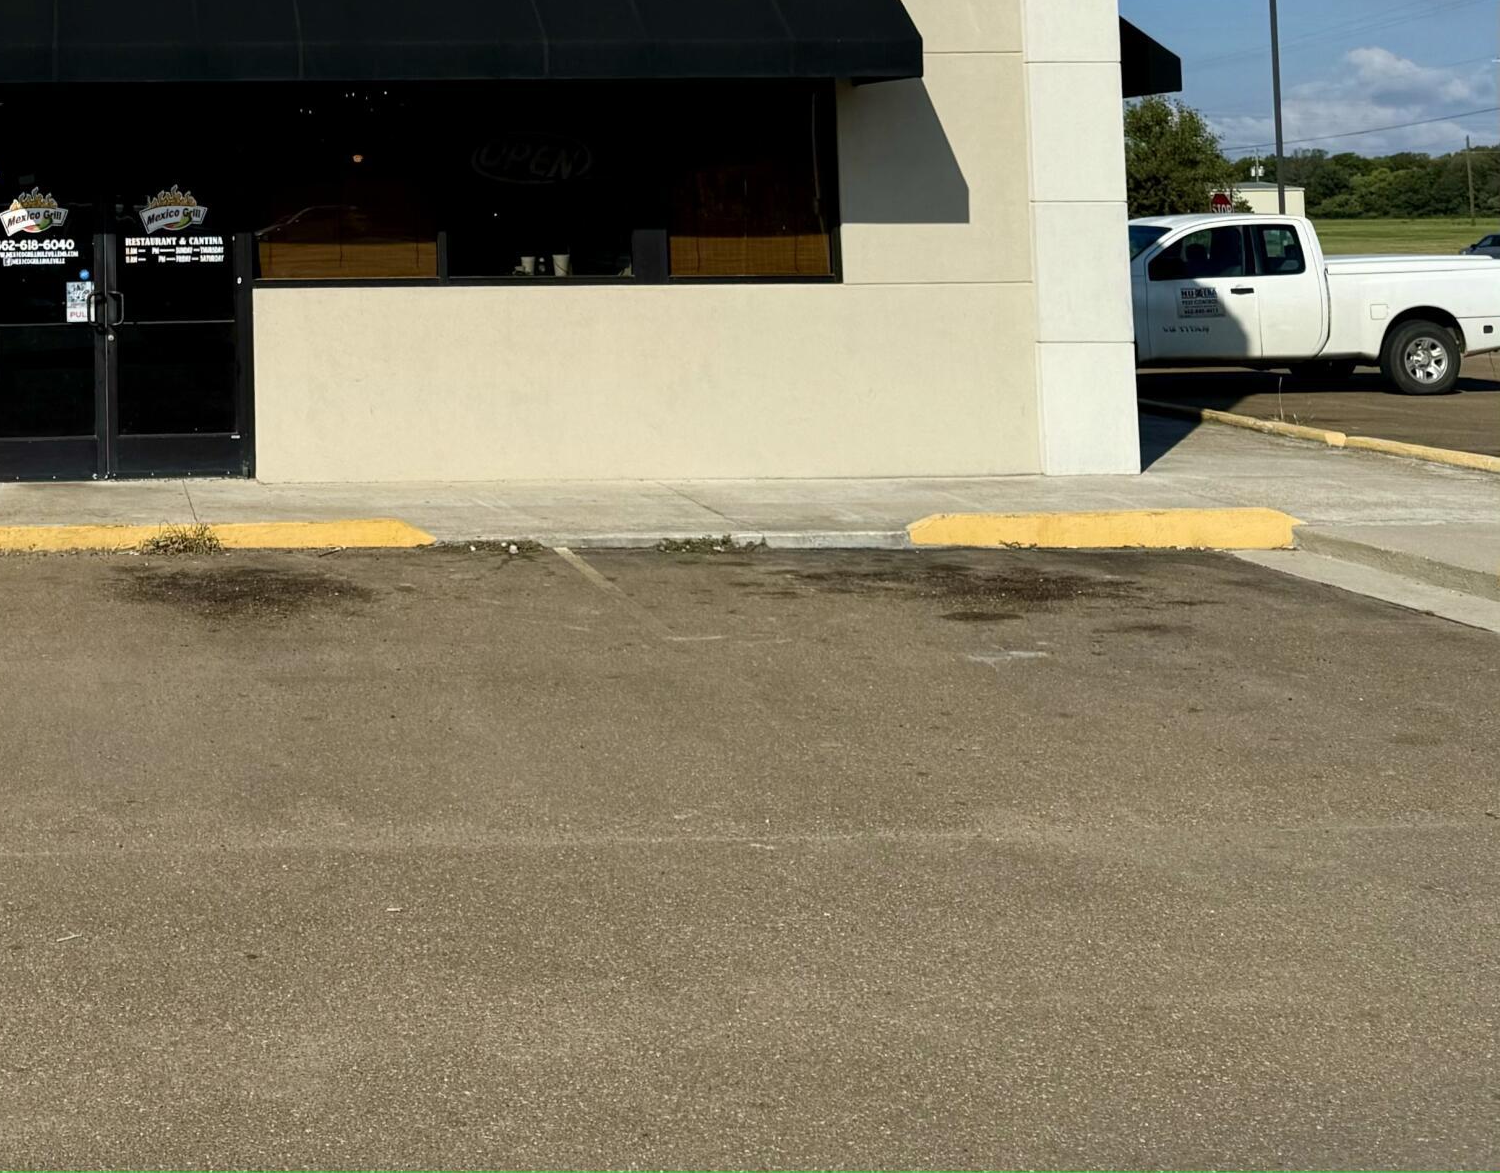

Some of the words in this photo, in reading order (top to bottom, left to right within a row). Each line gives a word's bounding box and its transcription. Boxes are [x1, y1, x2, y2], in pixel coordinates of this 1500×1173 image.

[478, 138, 581, 180] OPEN
[7, 211, 41, 227] Mexico
[43, 210, 62, 221] Grill
[147, 208, 180, 225] Mexico
[182, 207, 201, 219] Grill
[125, 237, 177, 246] RESTAURANT
[179, 237, 187, 245] &
[189, 236, 223, 245] CANTINA
